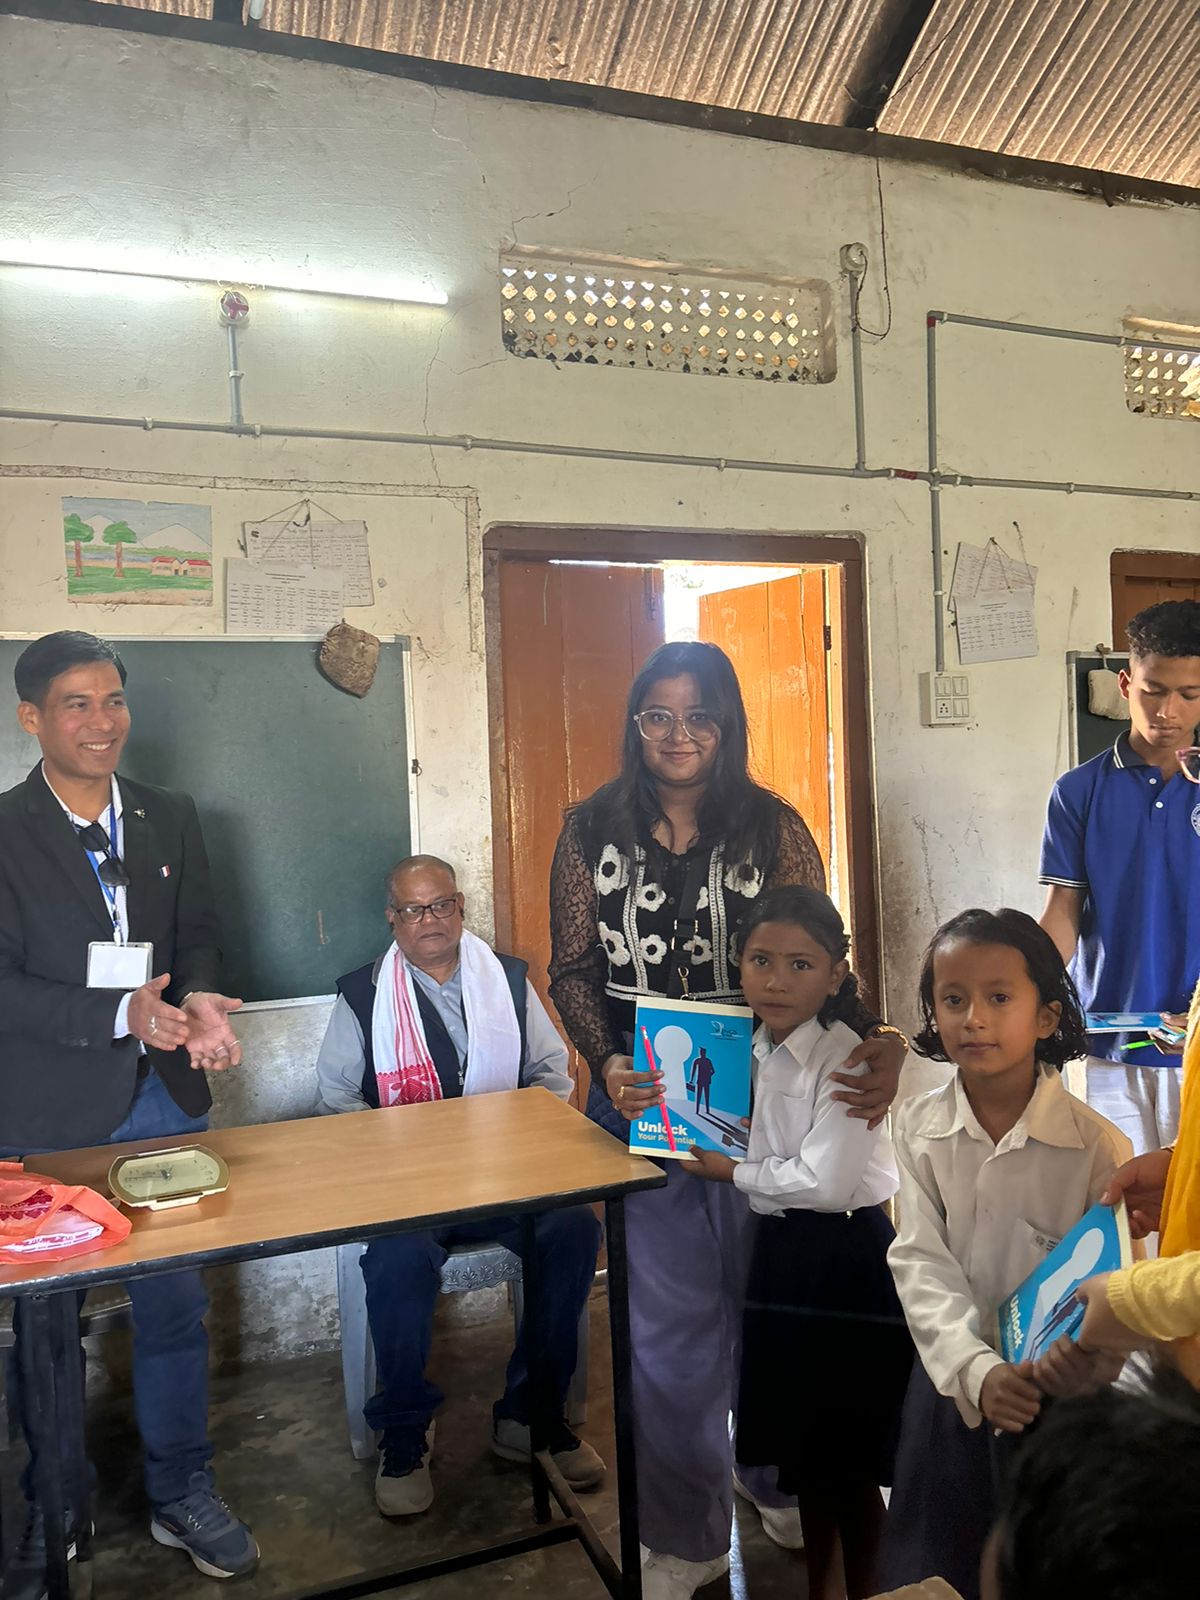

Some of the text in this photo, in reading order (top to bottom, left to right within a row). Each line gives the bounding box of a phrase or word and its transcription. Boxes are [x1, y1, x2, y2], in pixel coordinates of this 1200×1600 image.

[638, 1133, 696, 1145] Your Pontial
[1010, 1294, 1024, 1349] Unlock
